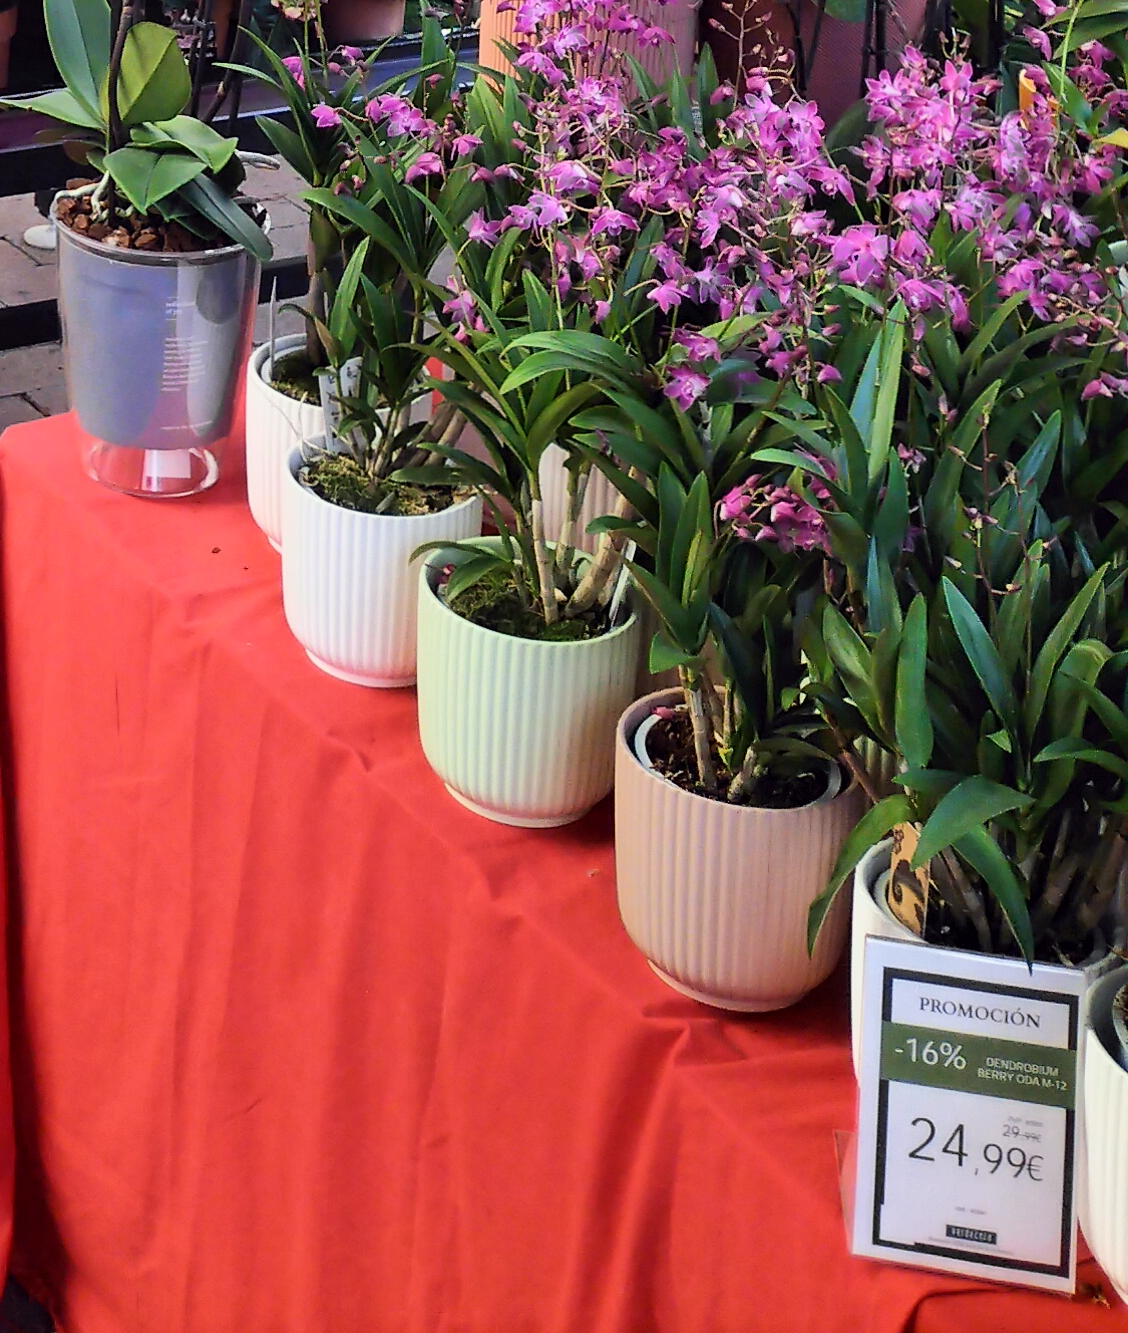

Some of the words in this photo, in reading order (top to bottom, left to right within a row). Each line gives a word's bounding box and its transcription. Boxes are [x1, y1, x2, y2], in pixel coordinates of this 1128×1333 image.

[919, 996, 1041, 1029] PROMOCIÓN
[894, 1037, 968, 1071] -16%
[986, 1056, 1060, 1077] DENDROBIUM
[977, 1067, 1015, 1084] BERRY
[908, 1117, 1045, 1182] 24,99€
